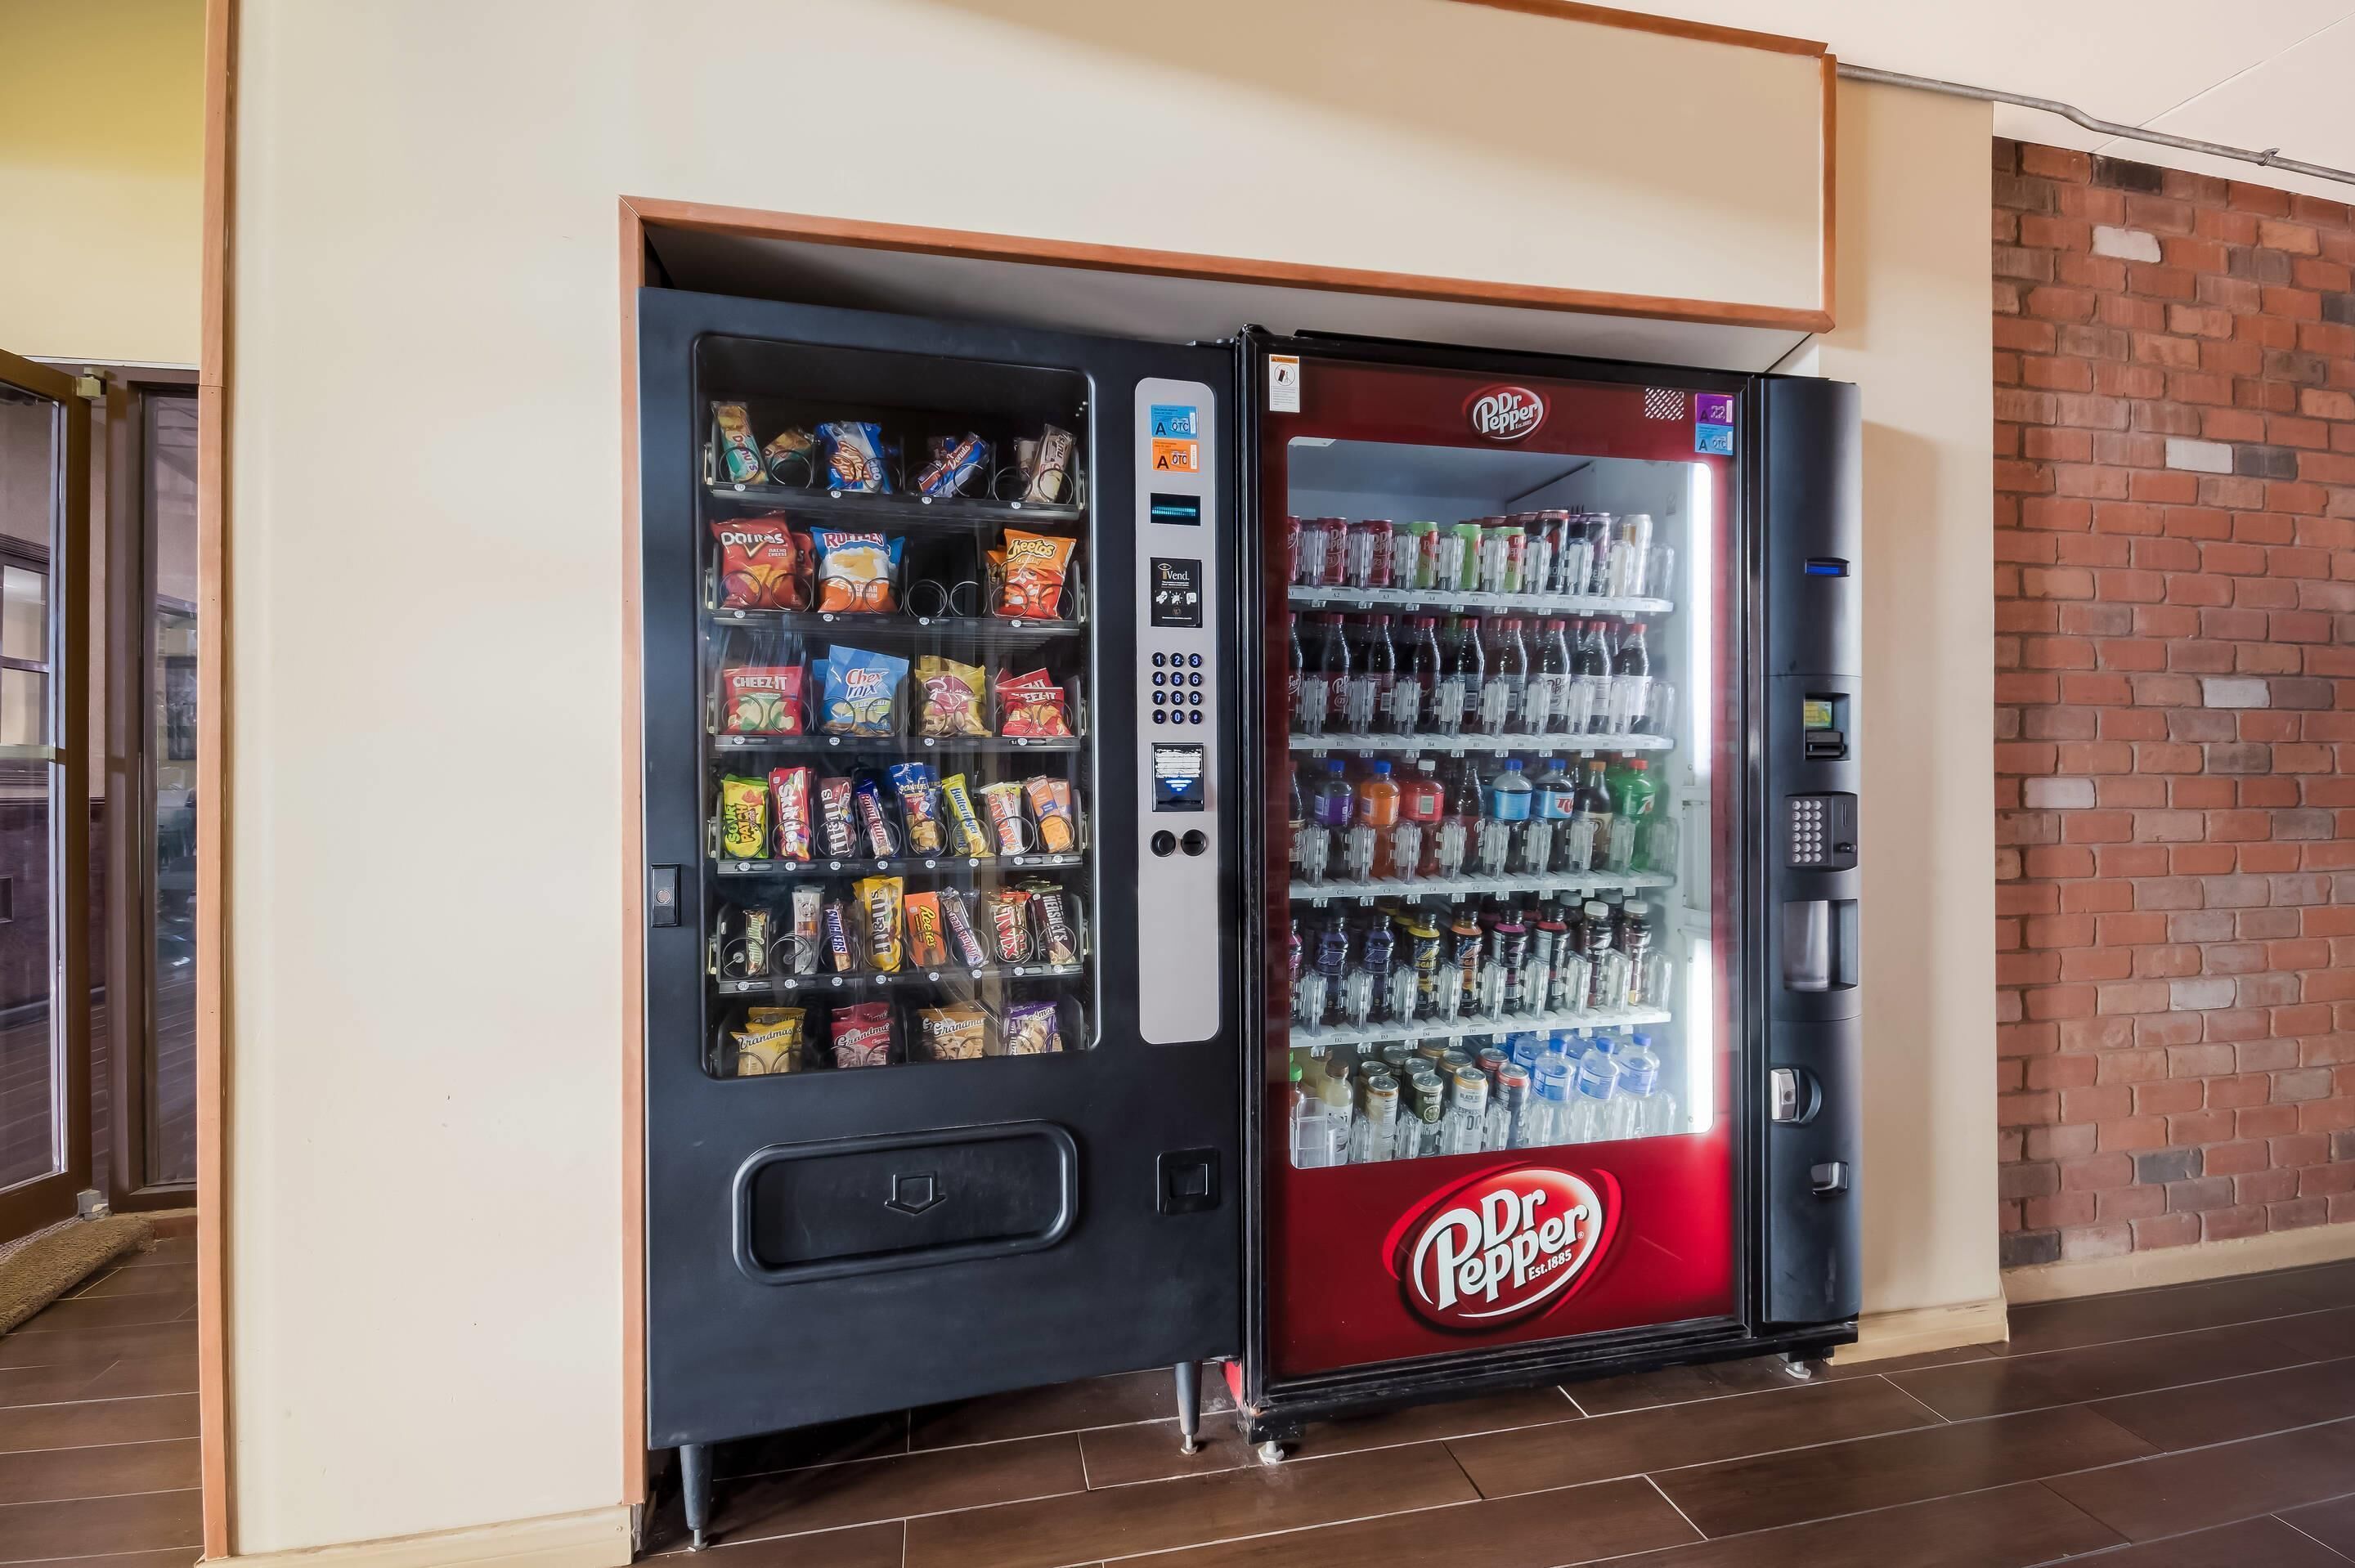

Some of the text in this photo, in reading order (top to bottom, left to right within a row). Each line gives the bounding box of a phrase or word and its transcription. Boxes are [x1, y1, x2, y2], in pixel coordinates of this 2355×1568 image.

[1474, 396, 1538, 433] Pepper
[1498, 392, 1522, 414] Dr
[1155, 422, 1166, 435] A
[1172, 422, 1189, 432] OTC
[948, 444, 971, 469] Donuts
[1699, 440, 1707, 450] A
[1157, 456, 1169, 468] A
[1173, 455, 1187, 465] OTC
[1007, 539, 1056, 561] Cheetos
[1156, 655, 1198, 665] 1 2 3
[733, 676, 787, 690] CHEEZ-IT
[846, 668, 888, 688] Chex
[1155, 674, 1198, 683] 4 5 6
[1156, 693, 1198, 702] 7 8 9
[1175, 713, 1180, 721] 0
[725, 804, 737, 843] SOUR
[779, 783, 801, 853] Skittles
[950, 787, 980, 835] Butterfinger
[827, 910, 846, 953] SNICKERS
[917, 904, 937, 948] Reese's
[1043, 896, 1067, 943] HERSHEY'S
[994, 906, 1017, 959] TWIX
[1480, 1189, 1546, 1250] Dr
[1414, 1205, 1588, 1310] Pepper
[1528, 1250, 1572, 1279] Est.1885
